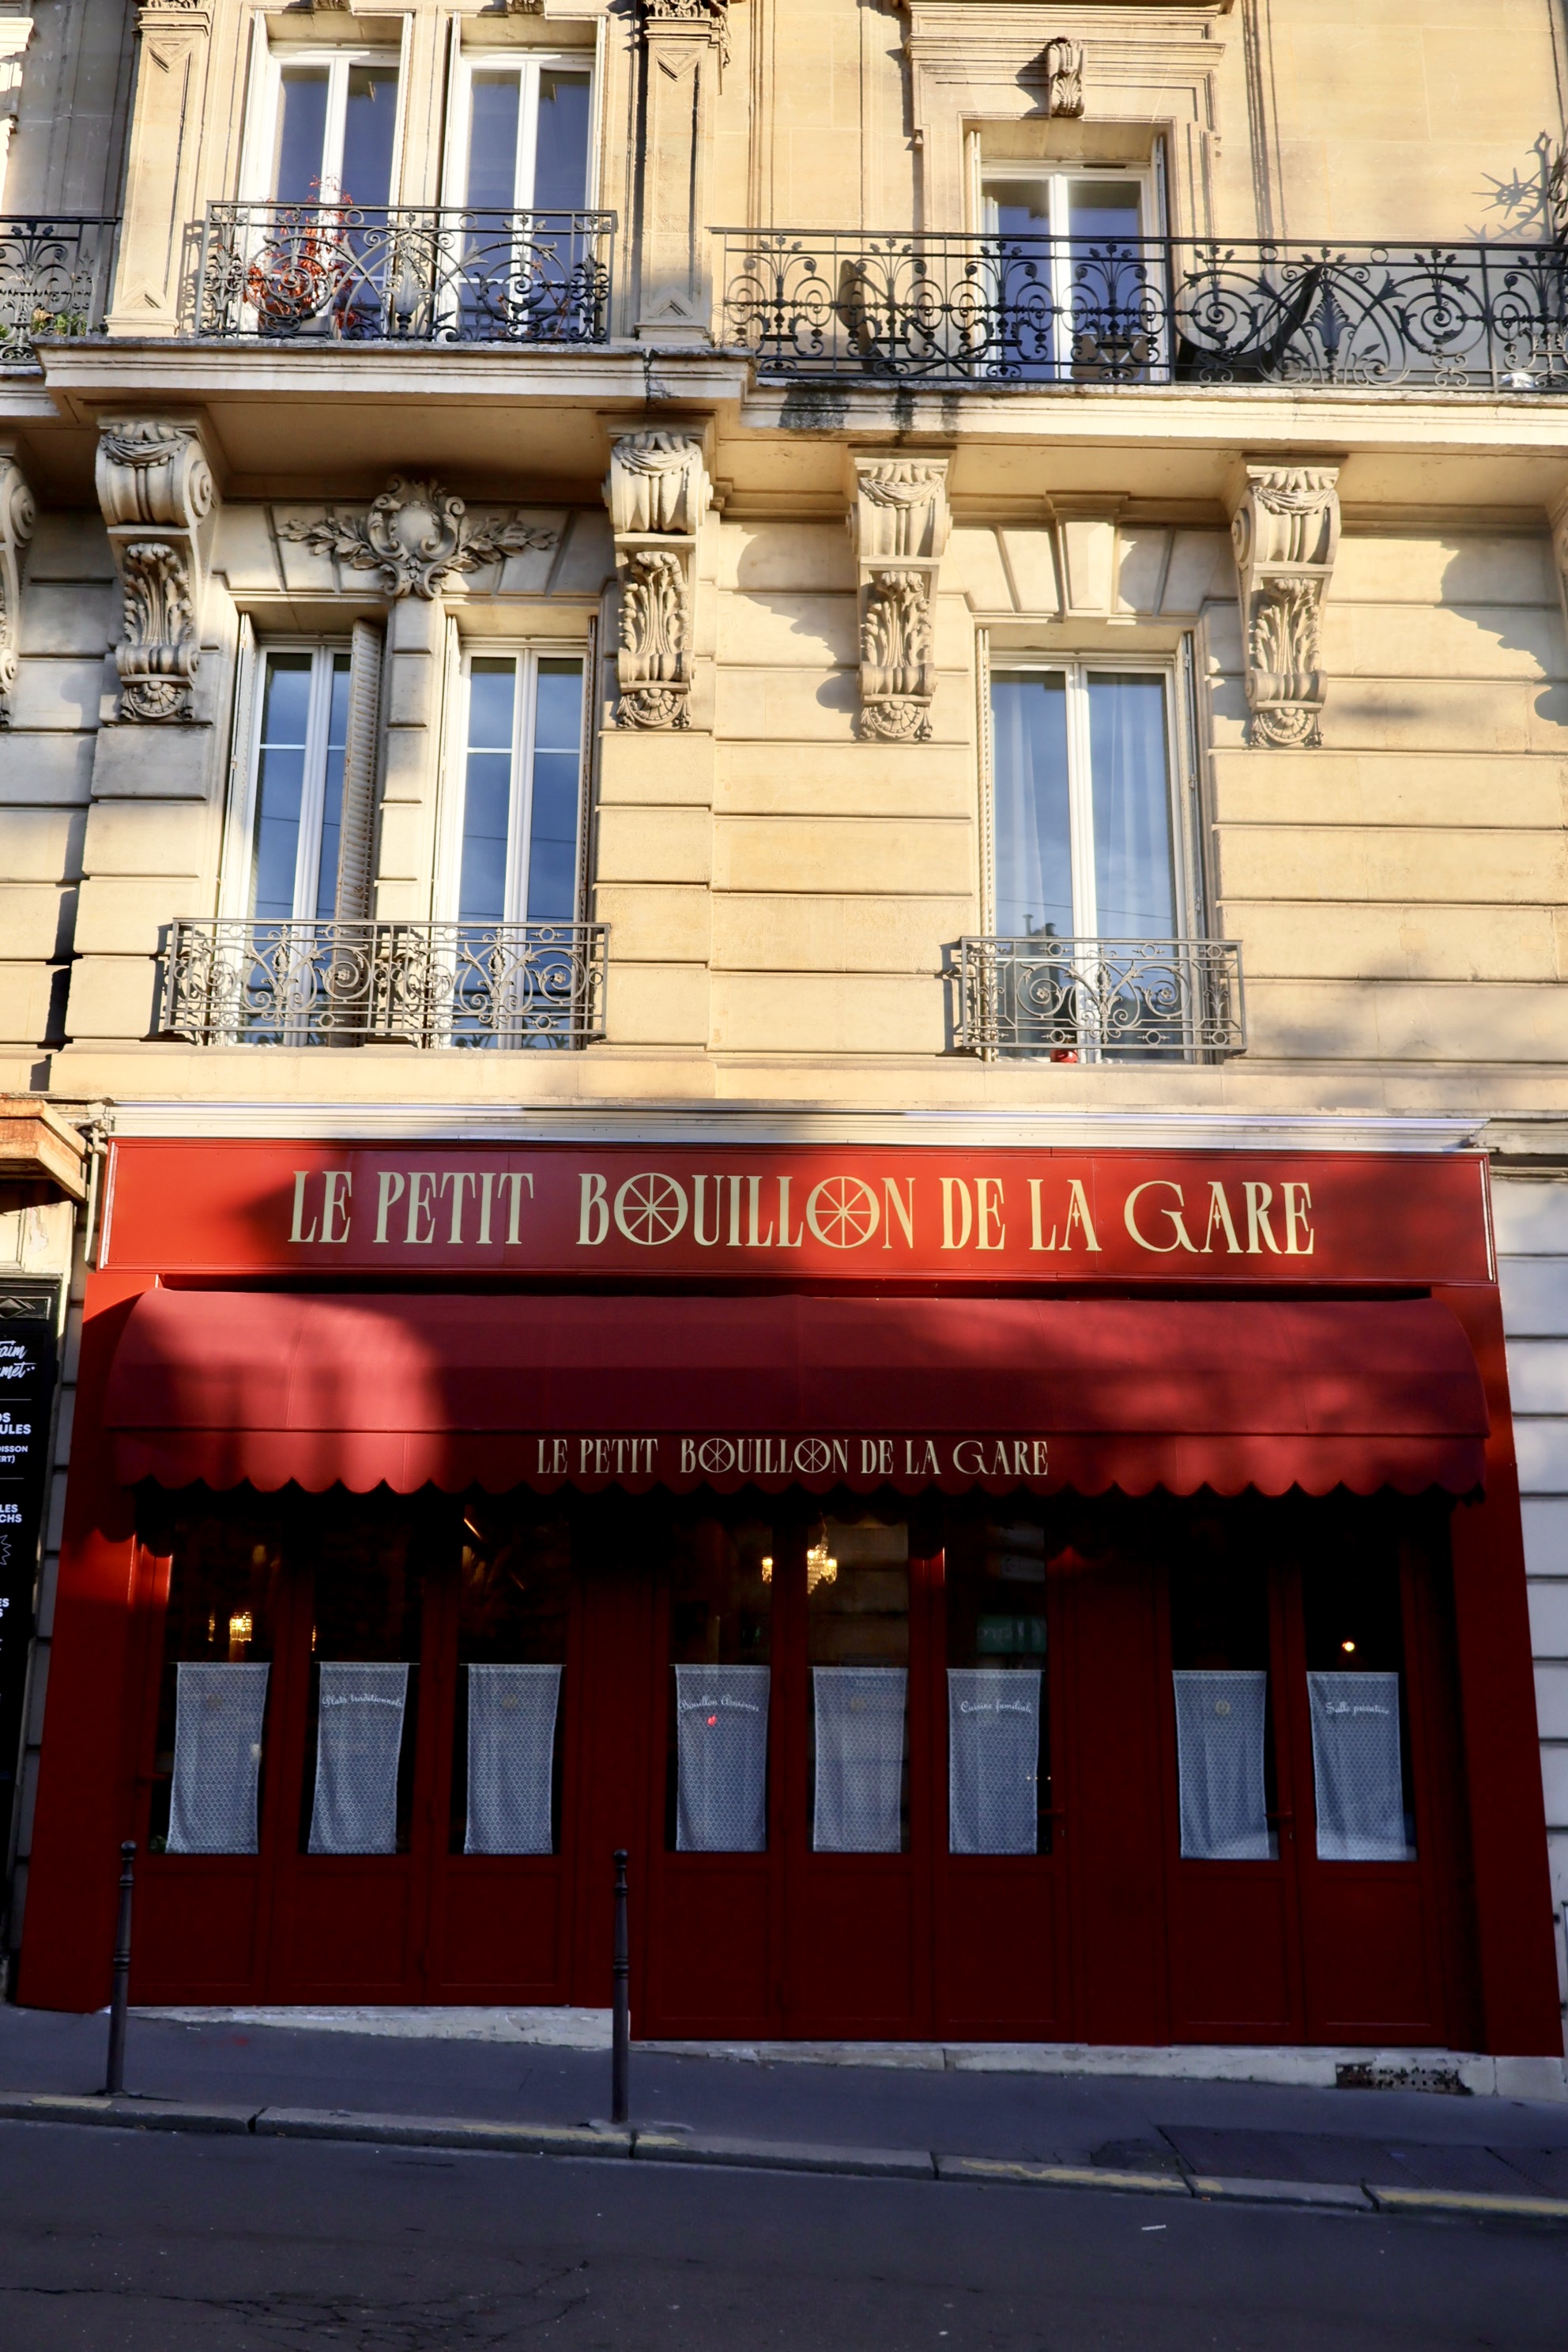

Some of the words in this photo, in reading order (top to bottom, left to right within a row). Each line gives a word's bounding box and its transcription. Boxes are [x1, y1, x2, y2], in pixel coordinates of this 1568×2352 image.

[288, 1170, 352, 1243] LE
[372, 1171, 534, 1245] PETIT
[575, 1172, 916, 1250] BOUILLON
[939, 1177, 1005, 1250] DE
[1027, 1178, 1102, 1252] LA
[1123, 1180, 1314, 1255] GARE
[0, 1340, 28, 1359] aim
[537, 1438, 568, 1474] LE
[579, 1438, 658, 1473] PETIT
[680, 1438, 849, 1473] BOUILLON
[861, 1439, 894, 1474] DE
[905, 1440, 942, 1475] LA
[952, 1440, 1048, 1476] GARE
